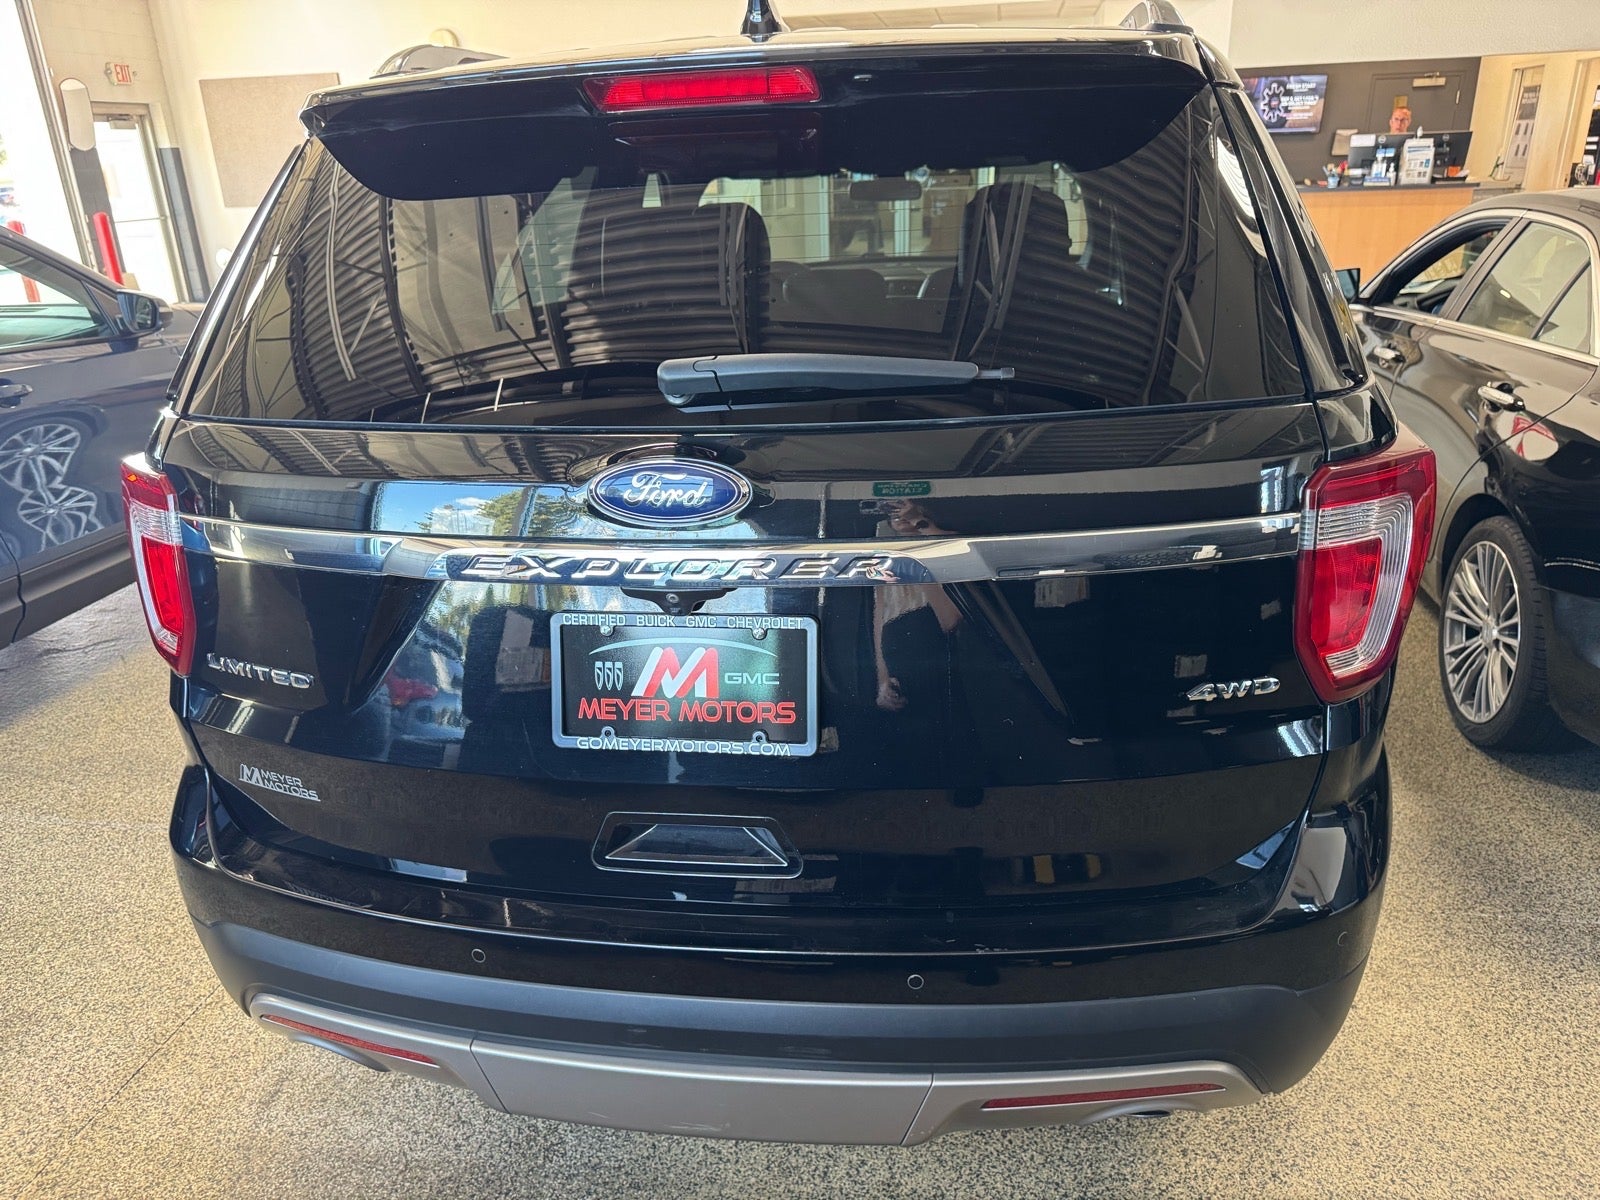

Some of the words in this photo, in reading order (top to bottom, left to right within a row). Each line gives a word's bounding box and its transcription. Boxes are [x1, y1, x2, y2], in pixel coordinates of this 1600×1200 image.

[113, 63, 132, 83] EXIT
[623, 471, 710, 507] Ford
[461, 553, 896, 581] EXPLORER
[562, 613, 626, 626] CERTIFIED
[636, 614, 676, 628] BUICK
[685, 616, 717, 629] GMC
[727, 617, 804, 630] CHEVROLET
[206, 653, 314, 689] LIMITED
[724, 672, 780, 685] GMC
[1186, 677, 1281, 702] 4WD
[578, 697, 672, 722] MEYER
[678, 700, 797, 724] MOTORS
[576, 737, 792, 757] GOMEYERMOTORS.COM
[261, 768, 303, 787] MEYER
[263, 780, 320, 801] MOTORS
